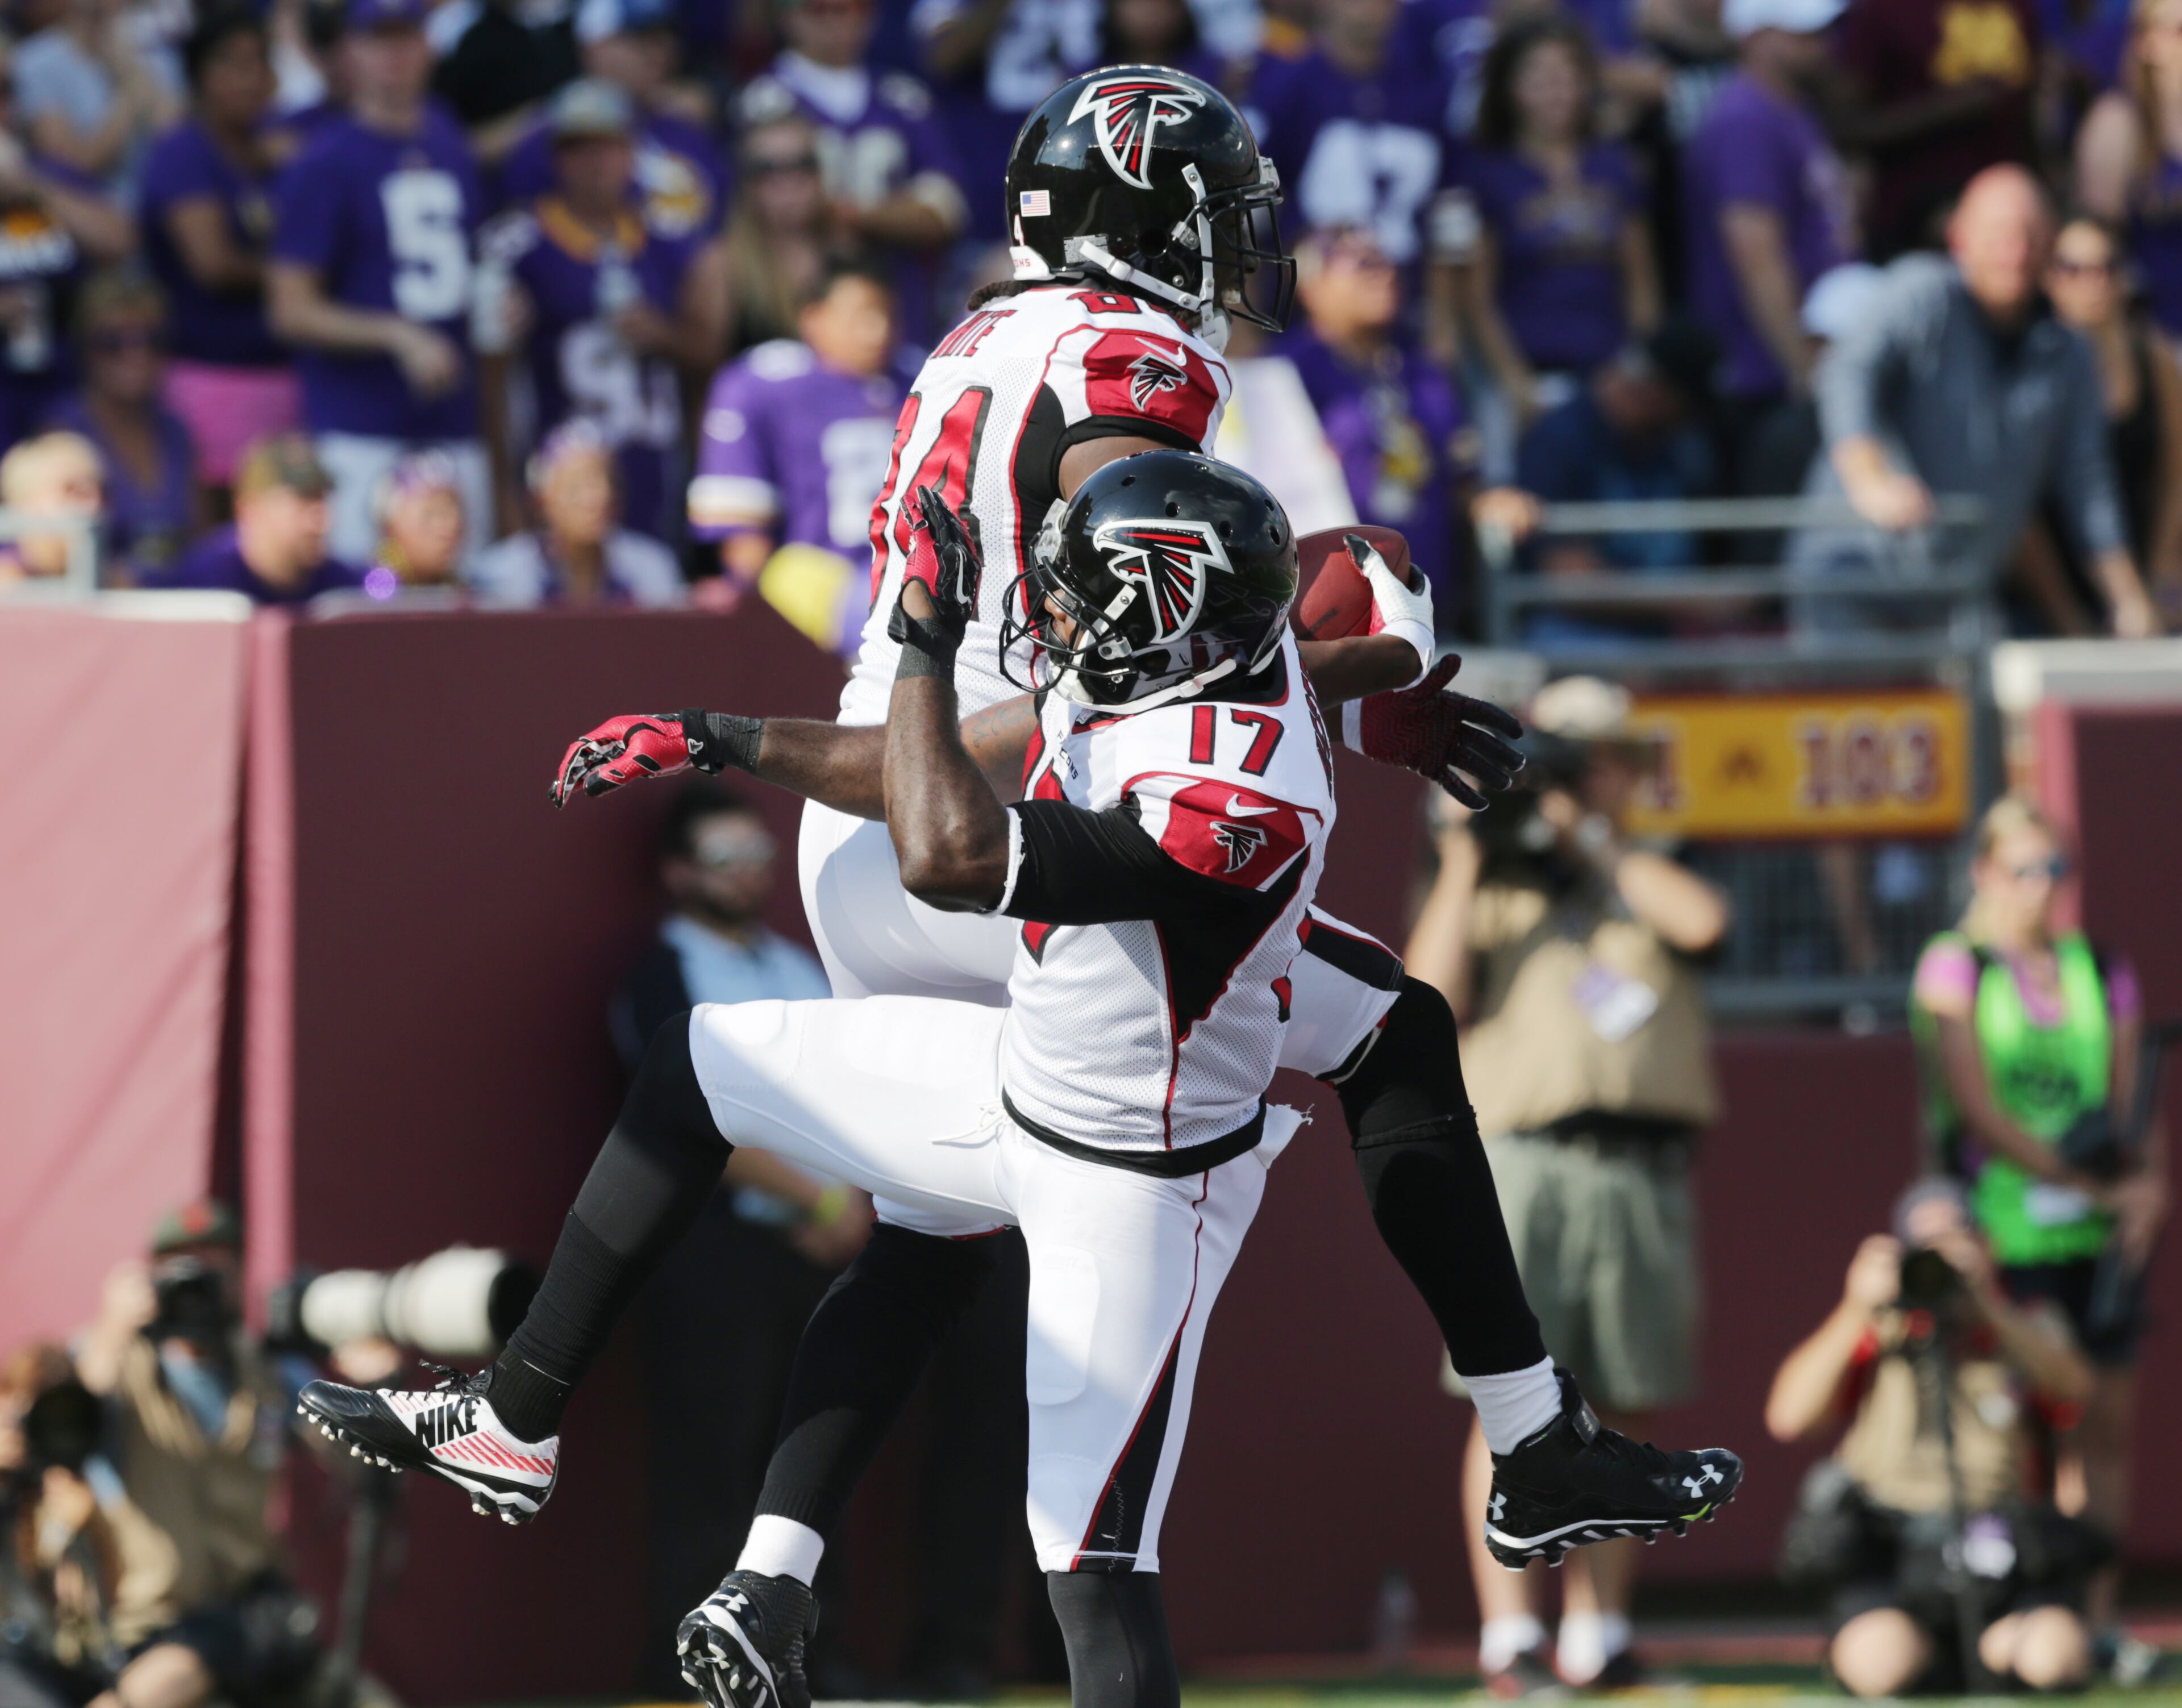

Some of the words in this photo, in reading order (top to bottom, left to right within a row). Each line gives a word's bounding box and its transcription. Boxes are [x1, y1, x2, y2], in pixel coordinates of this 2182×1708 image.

[1297, 118, 1443, 263] 47
[381, 169, 473, 322] 5
[1189, 705, 1285, 777] 17
[415, 1397, 477, 1449] NIKE
